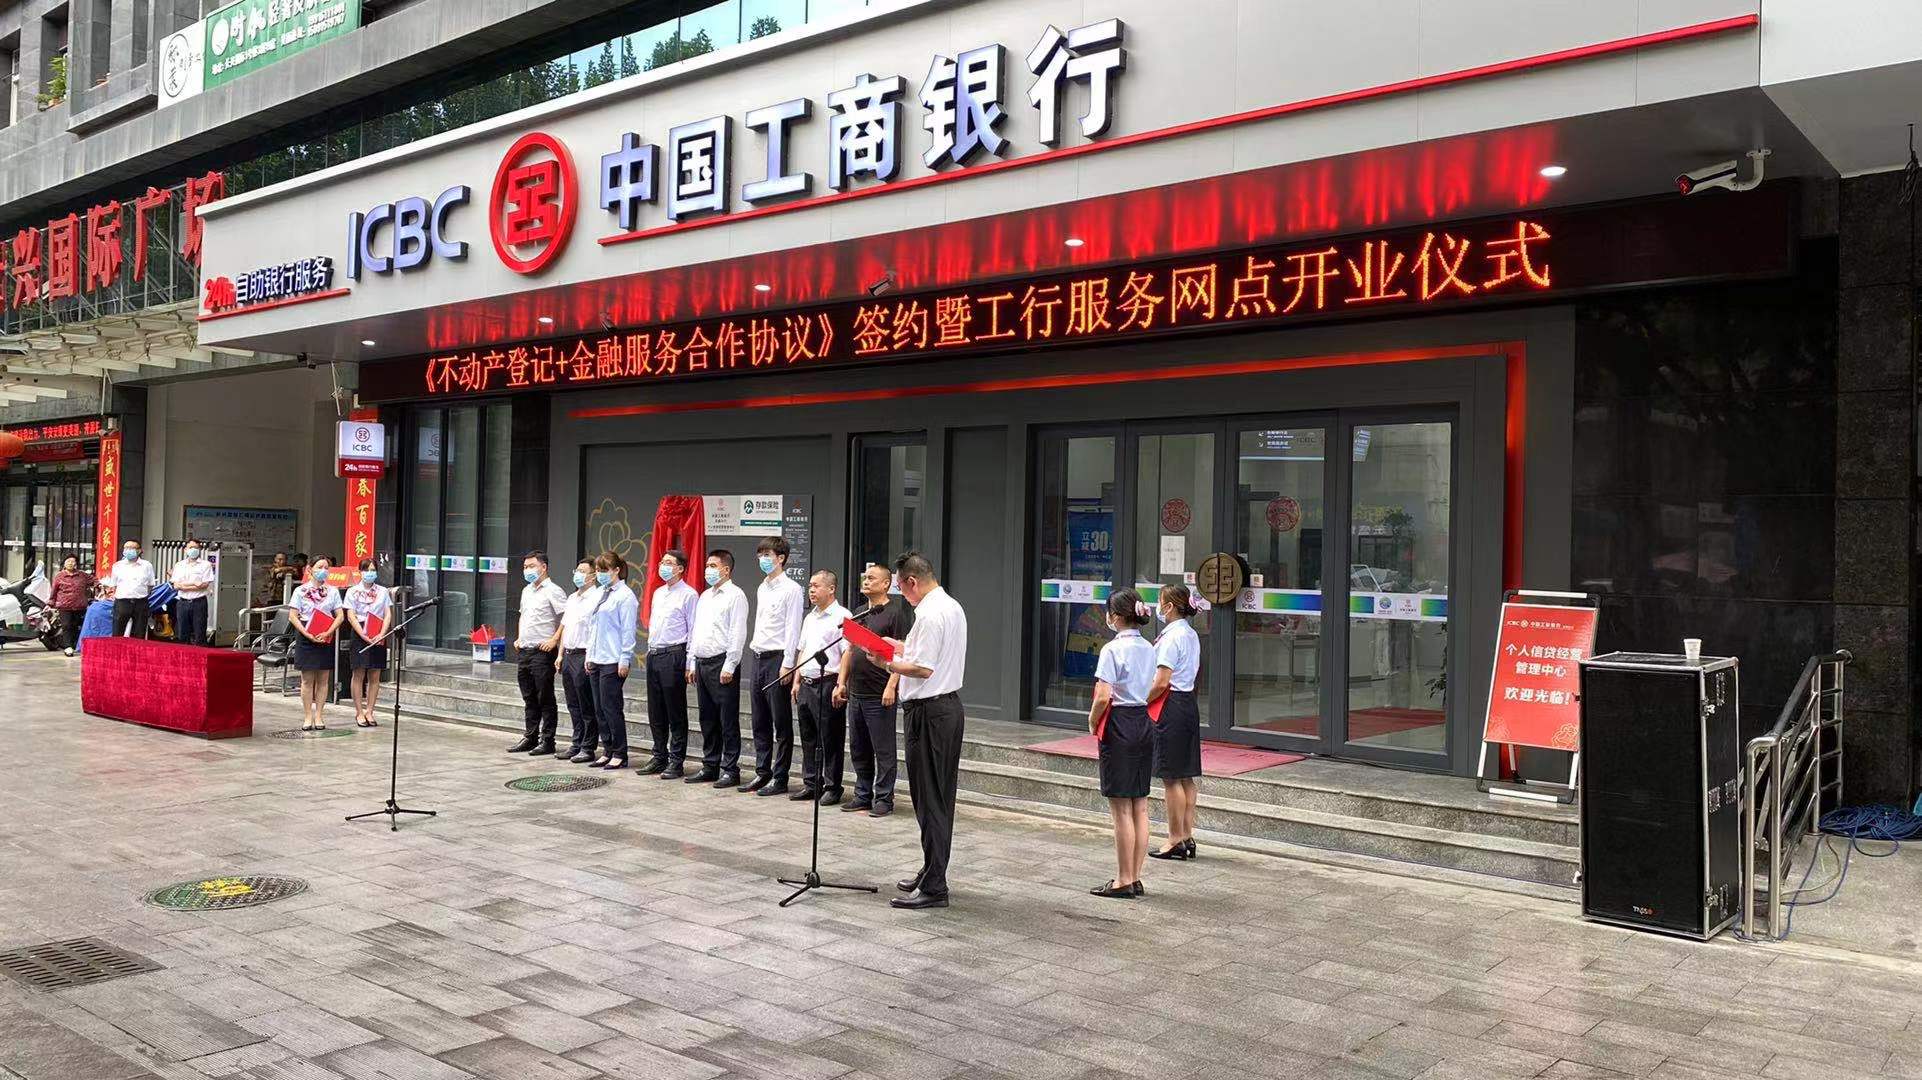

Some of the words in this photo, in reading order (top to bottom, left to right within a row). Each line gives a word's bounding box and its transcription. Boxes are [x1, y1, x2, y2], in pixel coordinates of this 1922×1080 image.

[600, 17, 1126, 231] 中国工商银行
[0, 171, 224, 313] 兴国际广场
[347, 185, 471, 281] ICBC
[236, 256, 332, 303] 自助银行服务
[352, 444, 372, 452] ICBC
[755, 500, 779, 509] 存款保险
[1091, 530, 1108, 552] 30
[786, 567, 805, 576] ETC
[1505, 643, 1583, 661] 个人信贷经营
[1515, 661, 1567, 678] 管理中心
